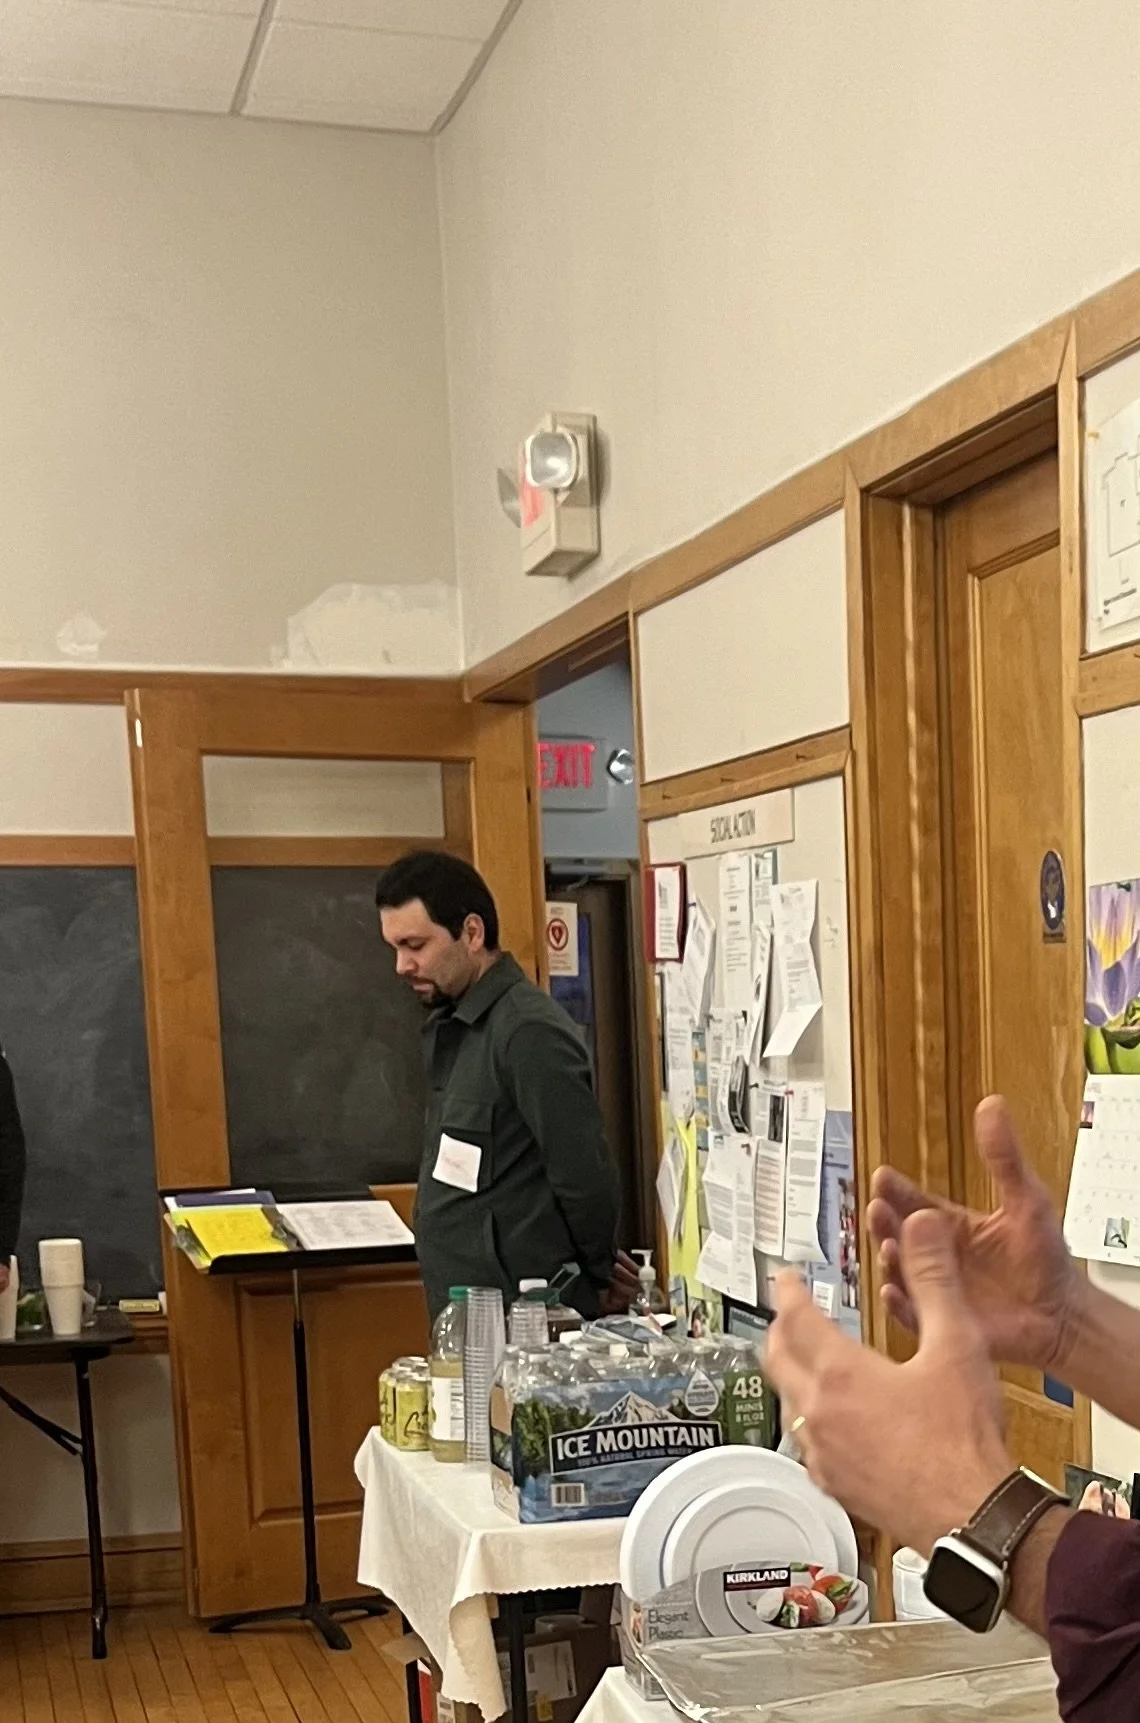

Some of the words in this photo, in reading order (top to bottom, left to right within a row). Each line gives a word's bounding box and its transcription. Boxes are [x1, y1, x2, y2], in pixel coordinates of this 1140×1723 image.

[536, 742, 595, 788] EXIT
[732, 1375, 763, 1399] 48
[556, 1434, 592, 1461] ICE
[596, 1426, 715, 1454] MOUNTAIN
[600, 1450, 634, 1464] NATURAL
[726, 1569, 789, 1584] KIRKLAND
[648, 1608, 689, 1625] Elegant
